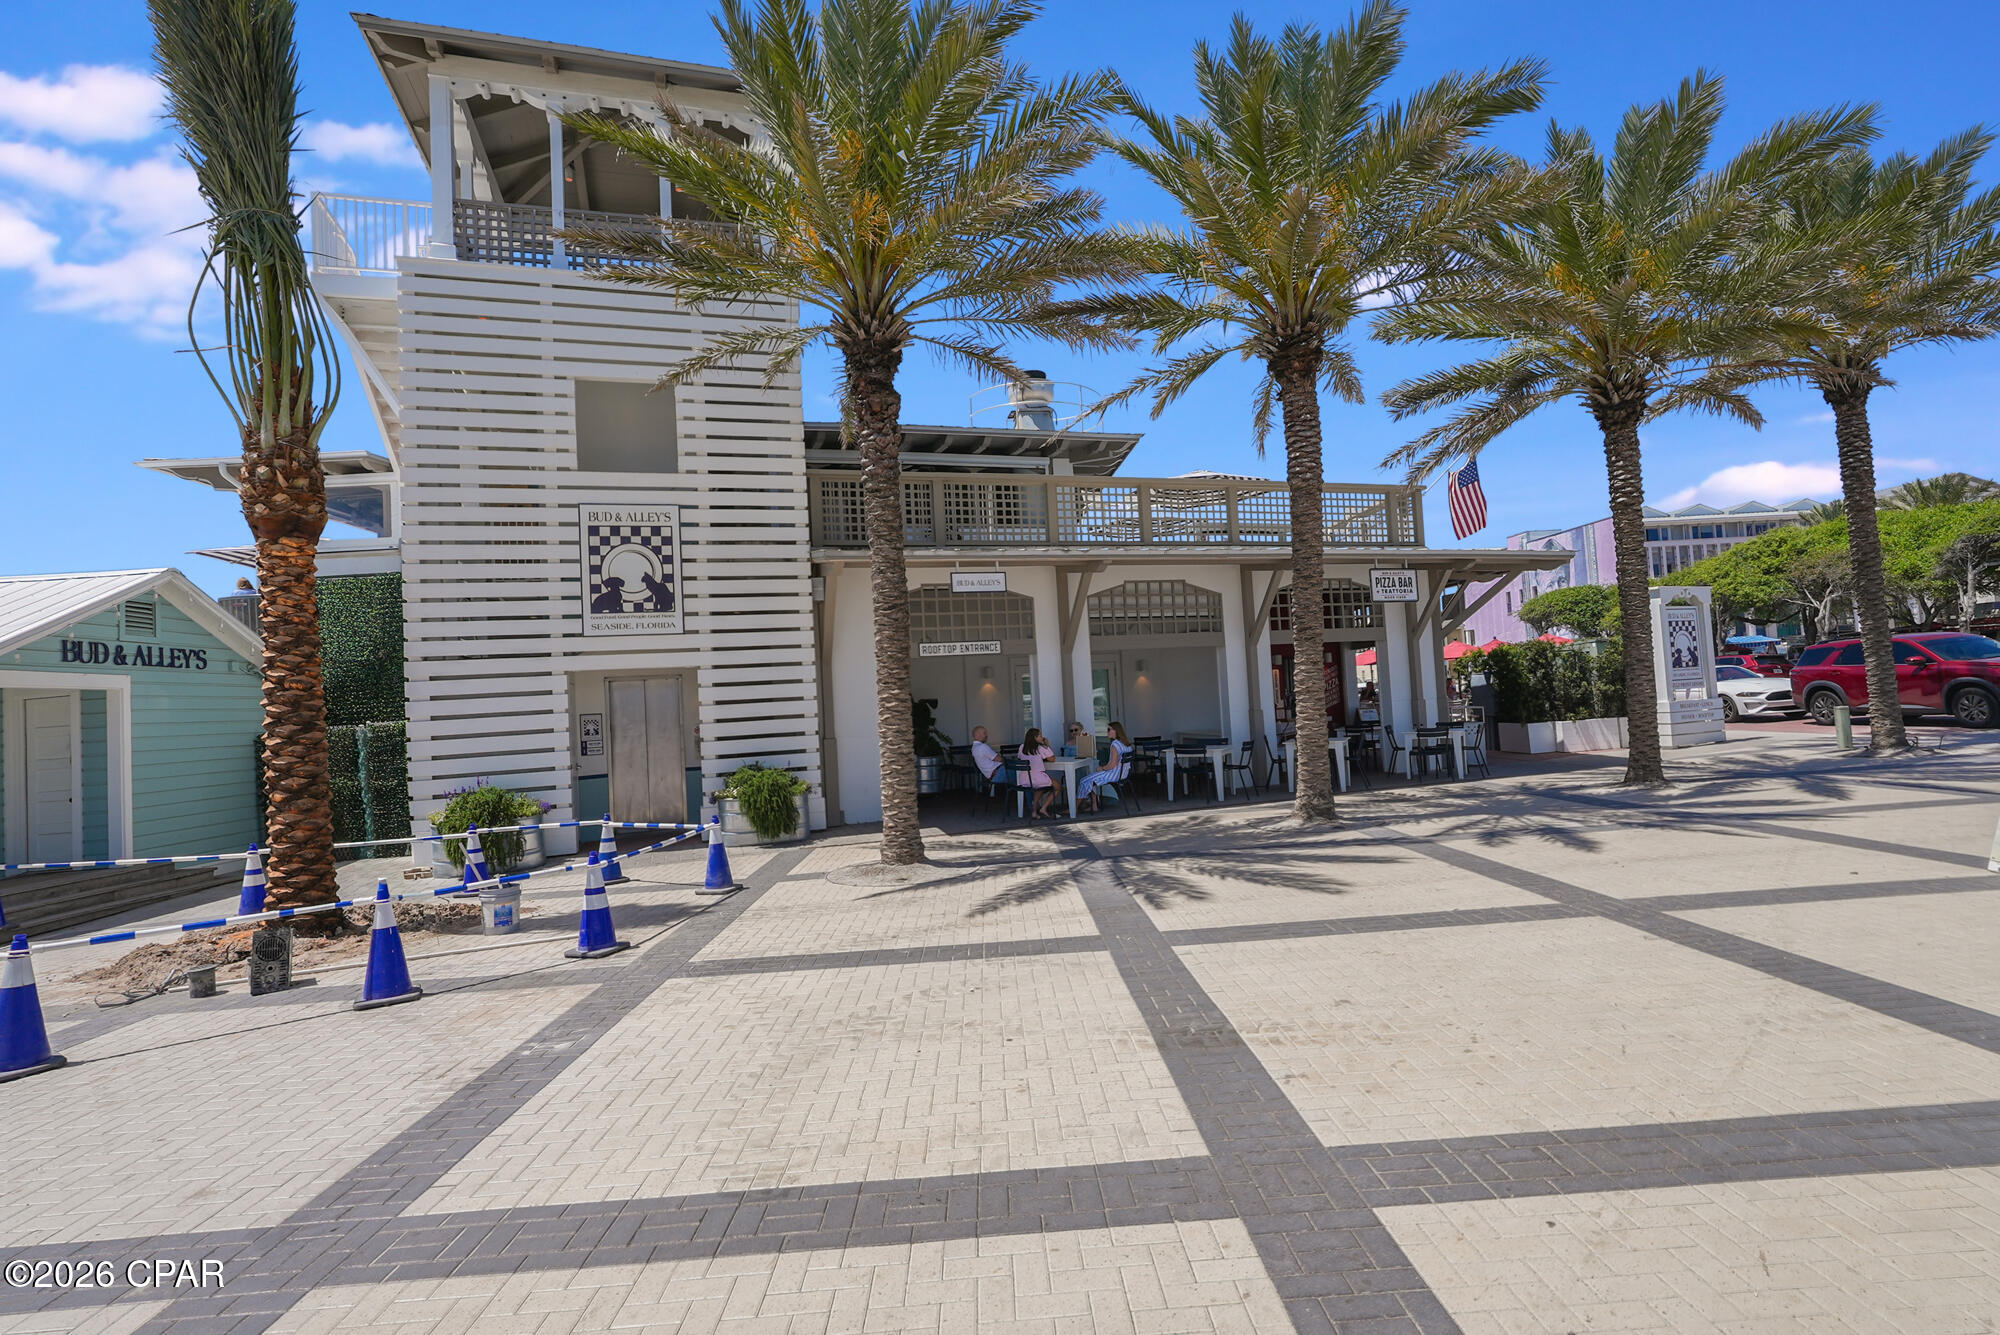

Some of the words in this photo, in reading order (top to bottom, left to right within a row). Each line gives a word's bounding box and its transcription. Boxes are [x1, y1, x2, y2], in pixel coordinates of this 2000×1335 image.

[588, 512, 612, 522] BUD
[615, 512, 622, 522] &
[626, 512, 672, 523] ALLEY'S
[1375, 576, 1396, 588] PIZZA
[1398, 576, 1413, 588] BAR
[636, 621, 676, 629] FLORIDA
[61, 639, 110, 665] BUD
[113, 644, 129, 666] &
[132, 645, 208, 670] ALLEY'S
[921, 645, 957, 655] ROOFTOP
[959, 643, 999, 653] ENTRANCE
